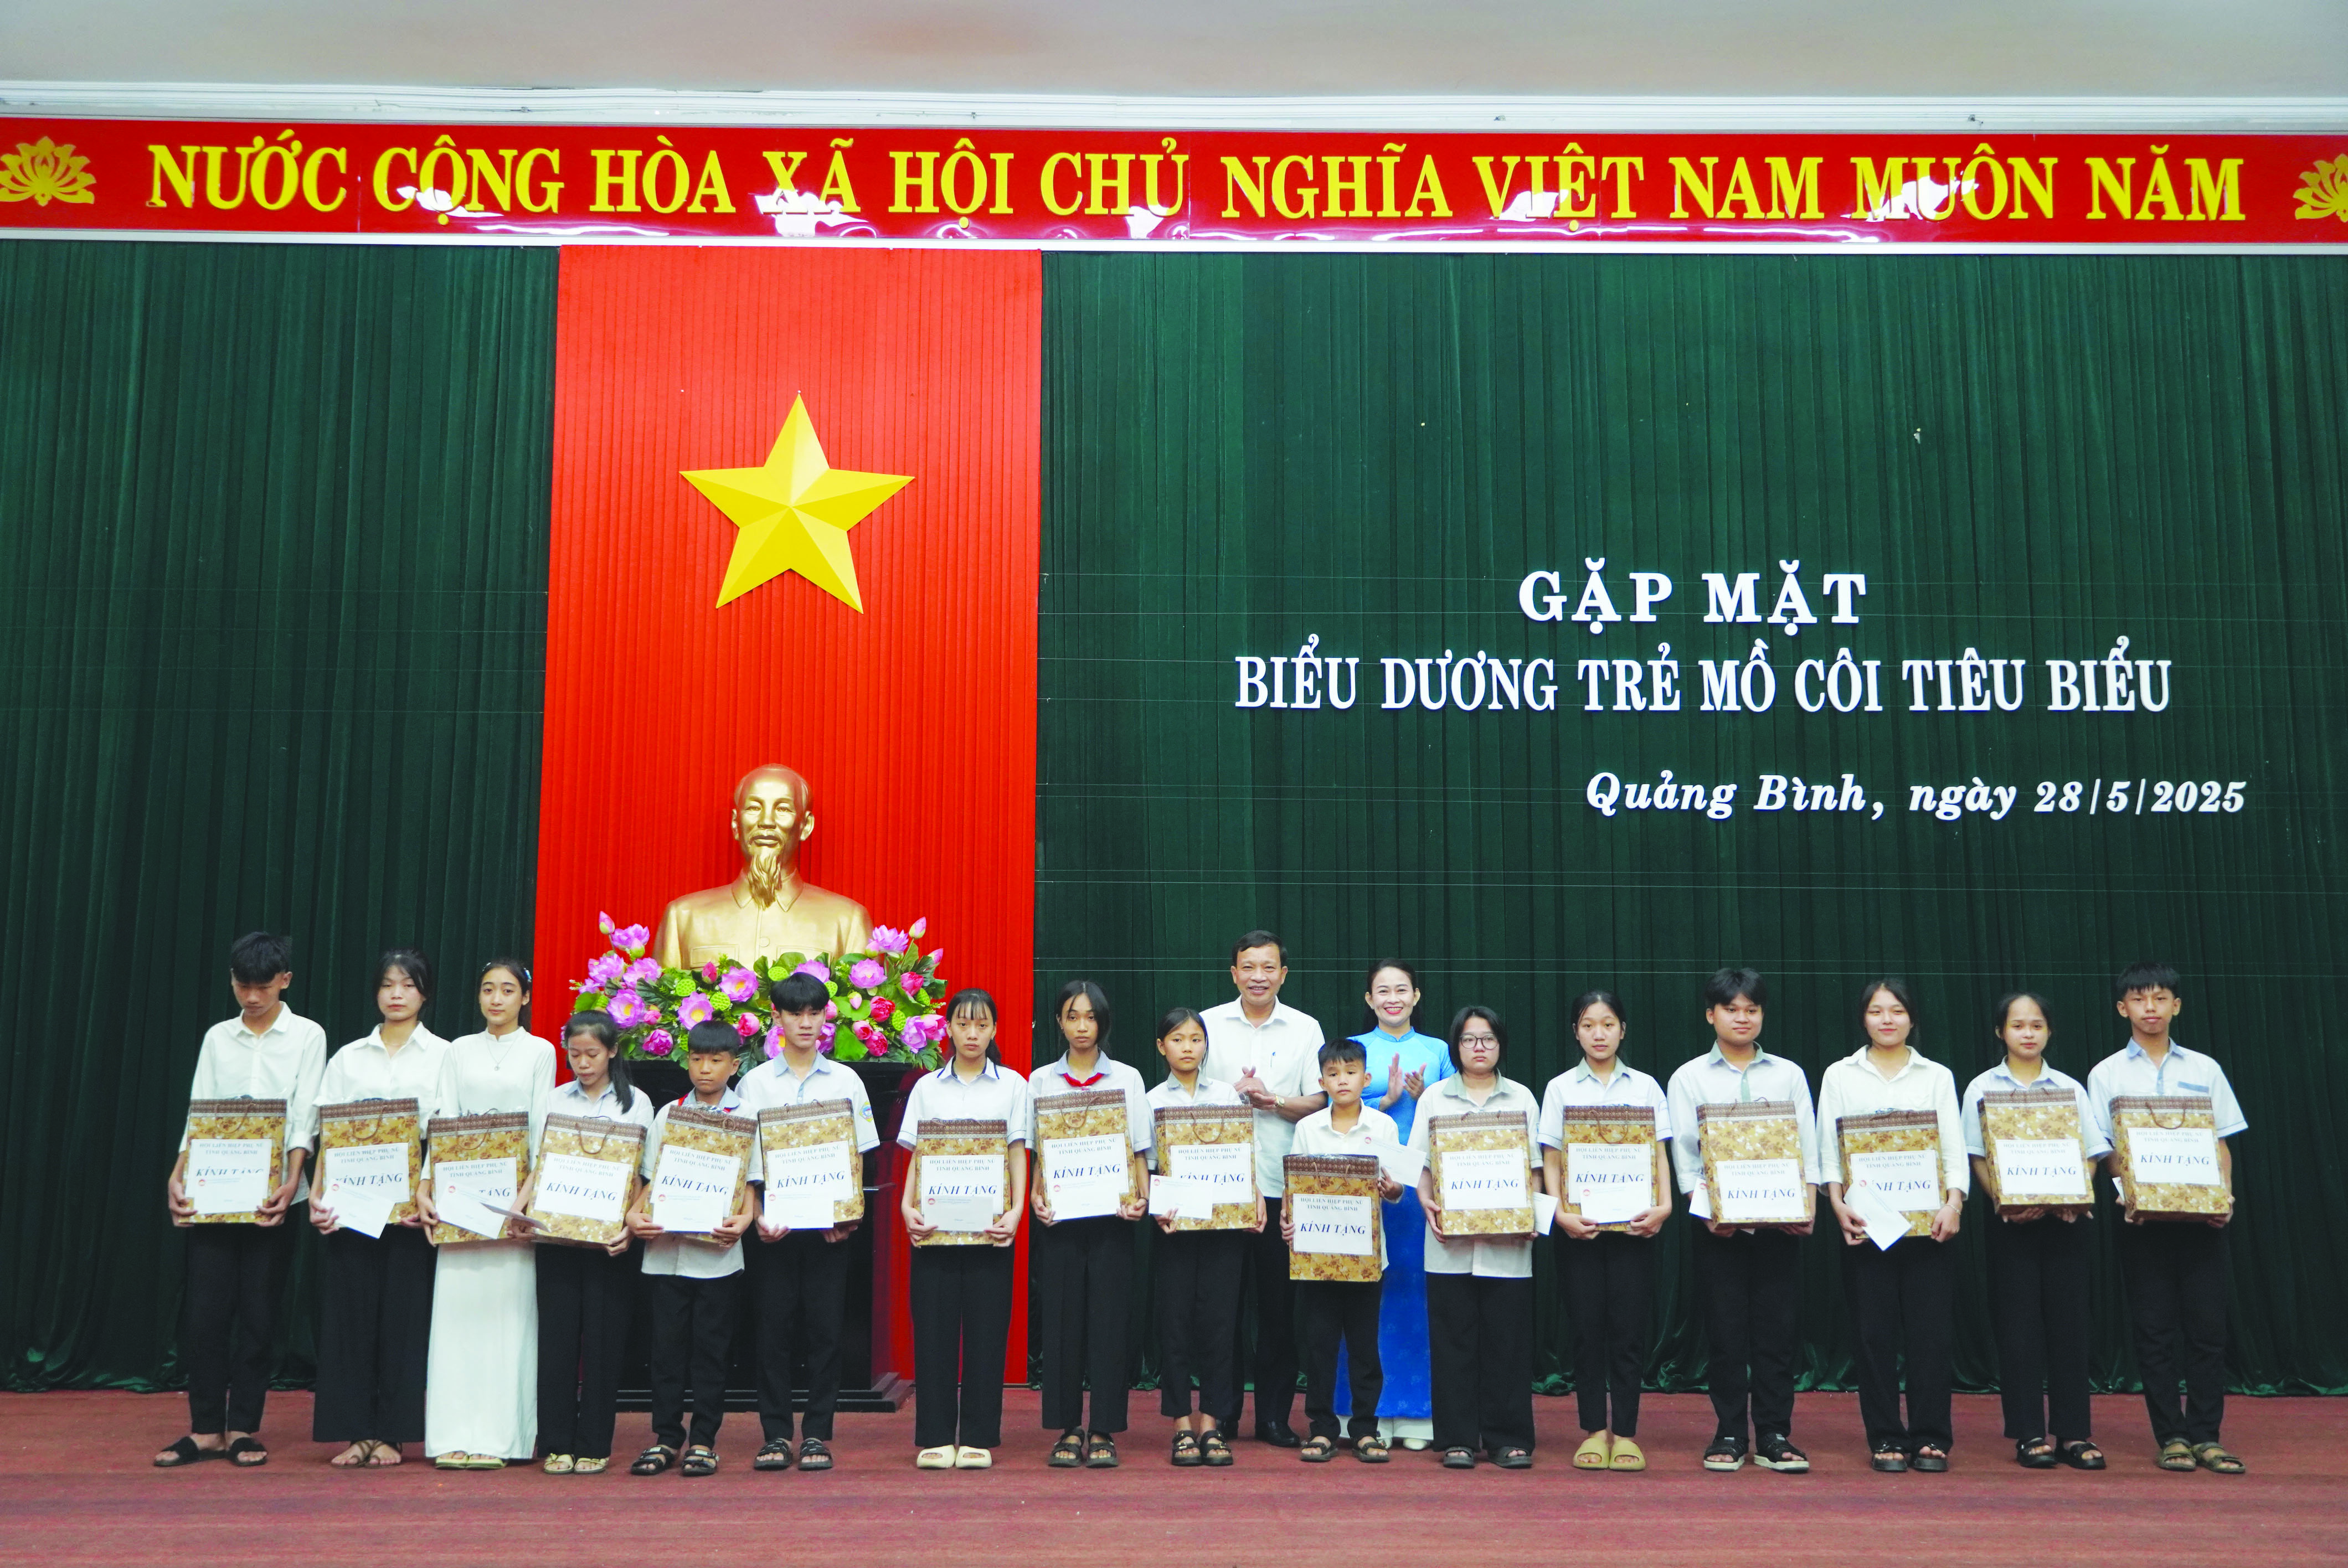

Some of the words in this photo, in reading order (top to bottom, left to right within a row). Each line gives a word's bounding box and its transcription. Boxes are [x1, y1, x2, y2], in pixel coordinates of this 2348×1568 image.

[148, 129, 347, 212] NƯỚC
[373, 135, 564, 225] CỘNG
[589, 135, 736, 214] HÒA
[763, 138, 861, 213] XÃ
[888, 138, 1014, 226] HỘI
[1041, 137, 1189, 216] CHỦ
[1220, 142, 1453, 219] NGHĨA
[1472, 142, 1644, 224] VIỆT
[1669, 157, 1825, 219] NAM
[1850, 143, 2058, 220] MUÔN
[2085, 145, 2246, 220] NĂM
[1519, 557, 1672, 634] GẶP
[1701, 560, 1866, 636] MẶT
[1235, 633, 1360, 709] BIỂU
[1380, 649, 1558, 711] DƯƠNG
[1578, 642, 1680, 711] TRẺ
[1698, 638, 1775, 712] MỒ
[1795, 647, 1883, 712] CÔI
[1902, 647, 2026, 711] TIÊU
[2045, 636, 2171, 712] BIỂU
[1587, 770, 1737, 819] Quảng
[1753, 773, 1883, 820] Bình,
[1909, 776, 2016, 821] ngày
[2033, 778, 2246, 815] 28/5/2025
[2141, 1152, 2172, 1163] KÍNH
[2177, 1155, 2210, 1167] TẶNG
[1054, 1166, 1084, 1179] KÍNH
[1089, 1164, 1121, 1177] TẶNG
[1213, 1173, 1245, 1185] TẶNG
[1576, 1171, 1606, 1183] KÍNH
[2008, 1165, 2038, 1175] KÍNH
[2043, 1166, 2076, 1178] TẶNG
[336, 1175, 366, 1185] ÍNH
[371, 1173, 403, 1187] TẶNG
[661, 1174, 693, 1189] KÍNH
[777, 1175, 807, 1188] KÍNH
[813, 1172, 845, 1185] TẶNG
[1451, 1178, 1482, 1190] KÍNH
[1487, 1178, 1519, 1190] TẶNG
[1898, 1180, 1931, 1193] TẶNG
[547, 1182, 580, 1194] KÍNH
[584, 1188, 617, 1201] TẶNG
[929, 1183, 960, 1195] KÍNH
[1728, 1188, 1758, 1199] KÍNH
[1763, 1188, 1795, 1200] TẶNG
[1300, 1221, 1331, 1232] KÍNH
[1335, 1224, 1366, 1236] TẶNG
